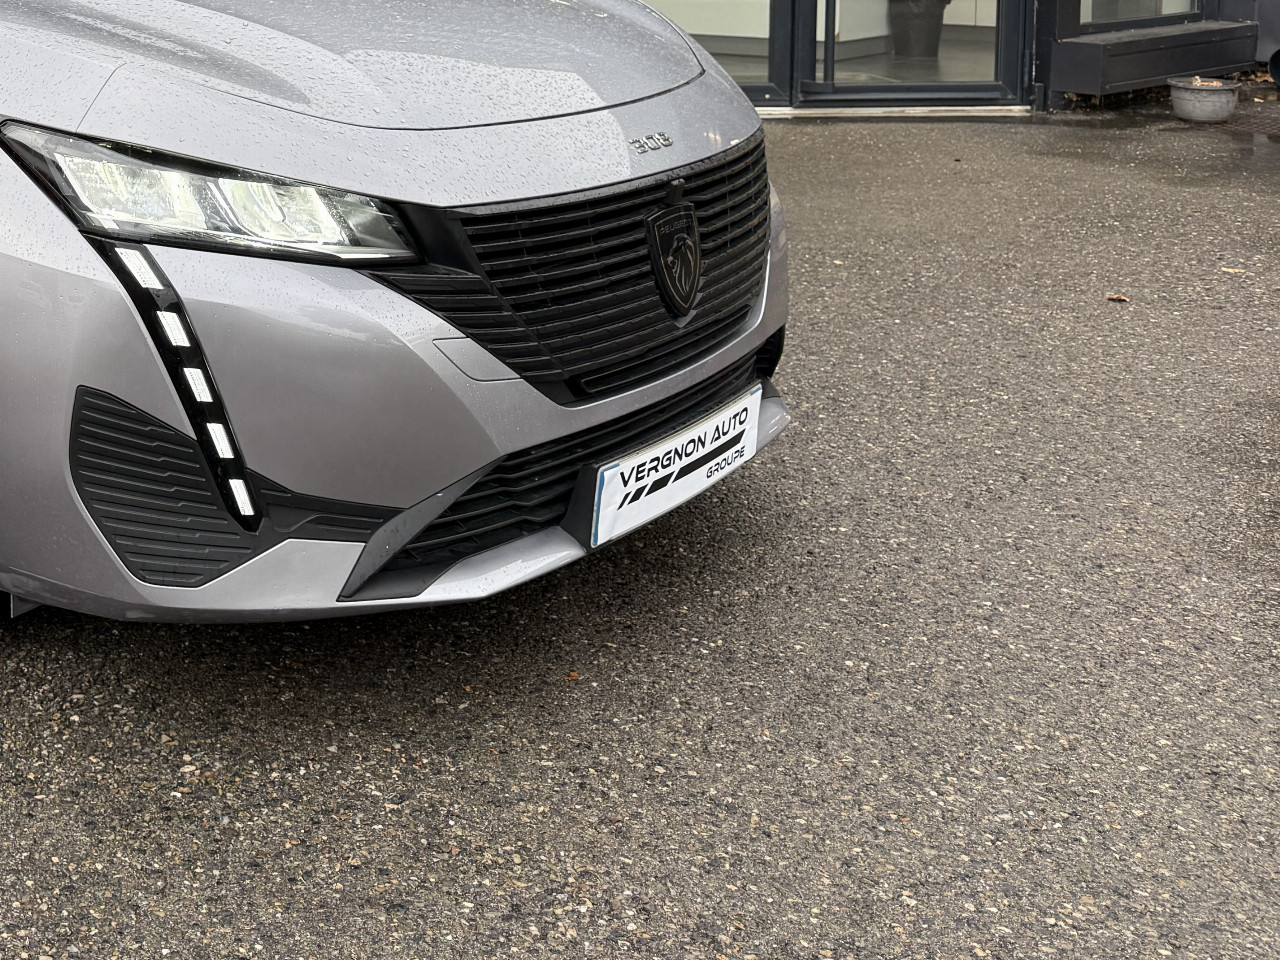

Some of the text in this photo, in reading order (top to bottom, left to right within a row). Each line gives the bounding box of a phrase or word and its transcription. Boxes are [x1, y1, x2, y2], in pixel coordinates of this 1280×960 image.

[628, 131, 674, 155] 308
[619, 406, 749, 488] VERGNON AUTO
[706, 445, 746, 479] GROUPE
